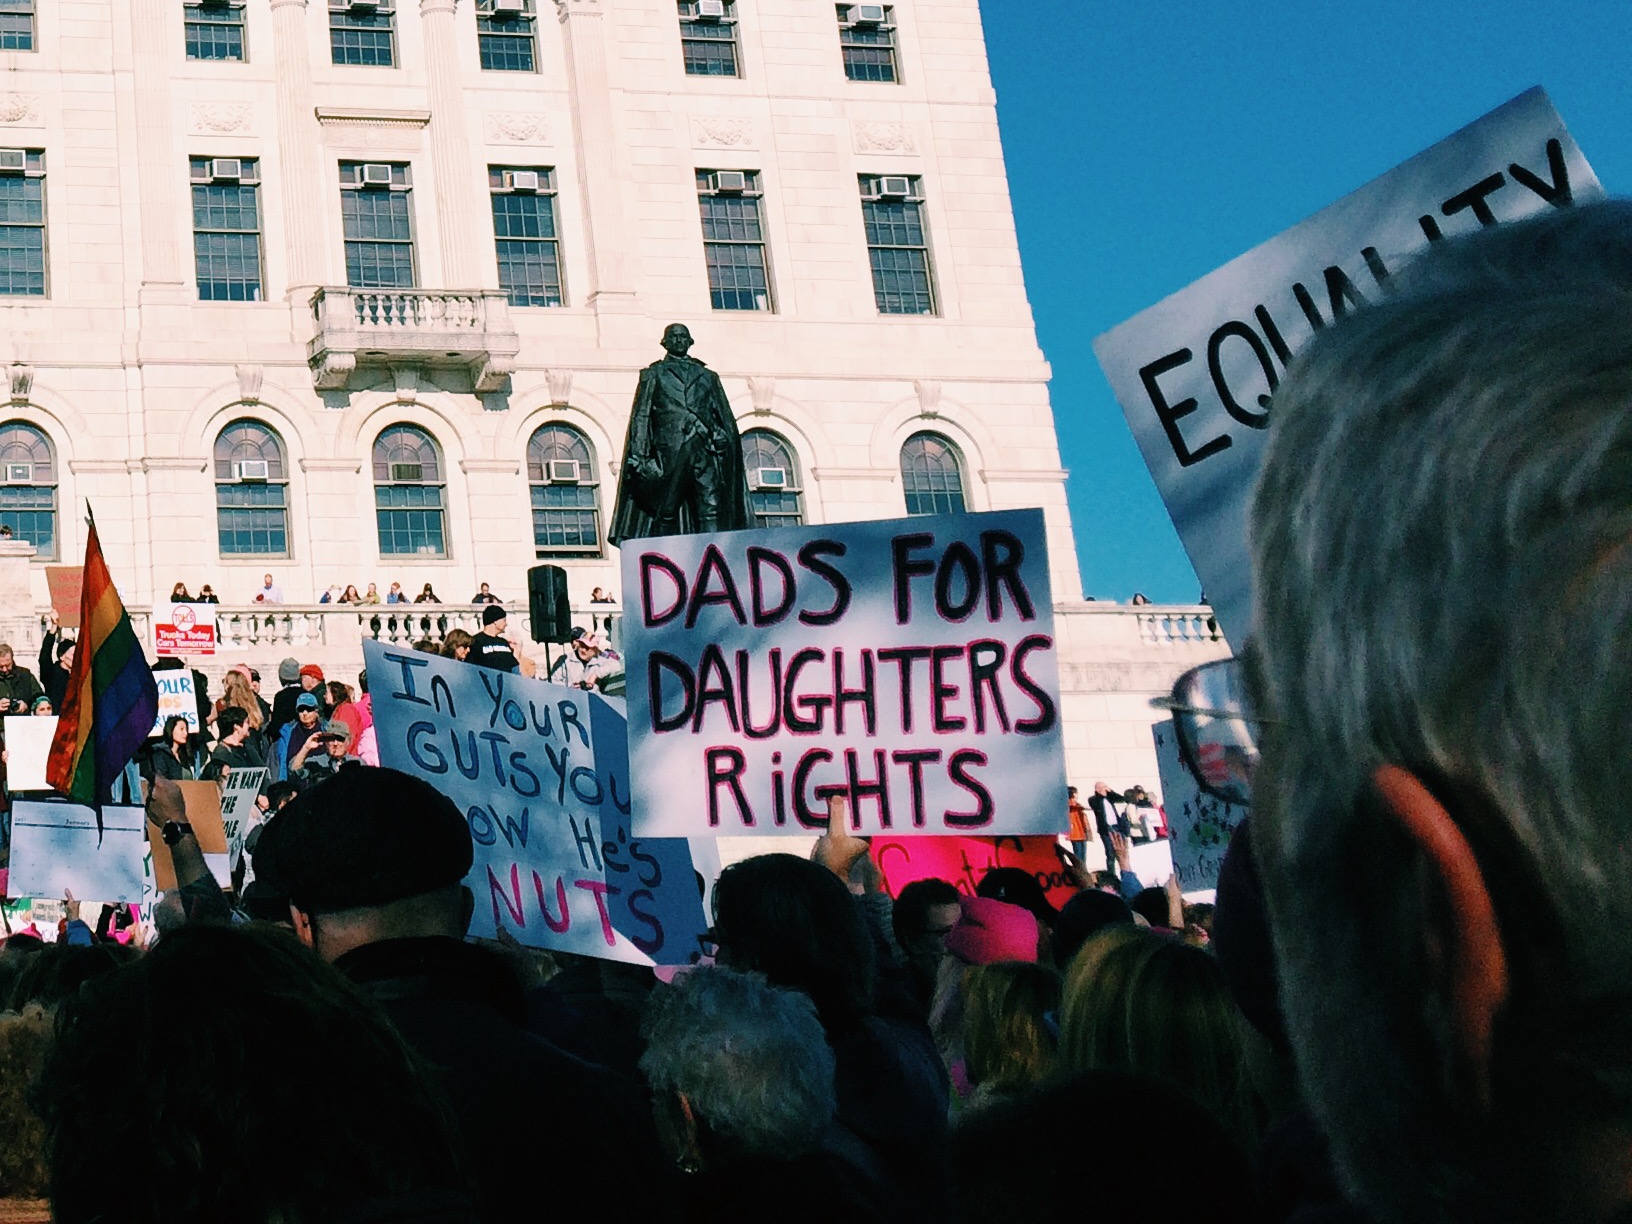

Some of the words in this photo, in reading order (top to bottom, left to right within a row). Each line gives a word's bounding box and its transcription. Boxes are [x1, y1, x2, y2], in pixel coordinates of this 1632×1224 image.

[1139, 137, 1573, 467] EQUTY
[639, 539, 852, 629] DADS
[891, 529, 1036, 625] FOR
[646, 634, 1057, 741] DAUGHTERS
[406, 721, 541, 797] GUTS
[467, 804, 529, 848] OW
[486, 863, 664, 954] NUTS
